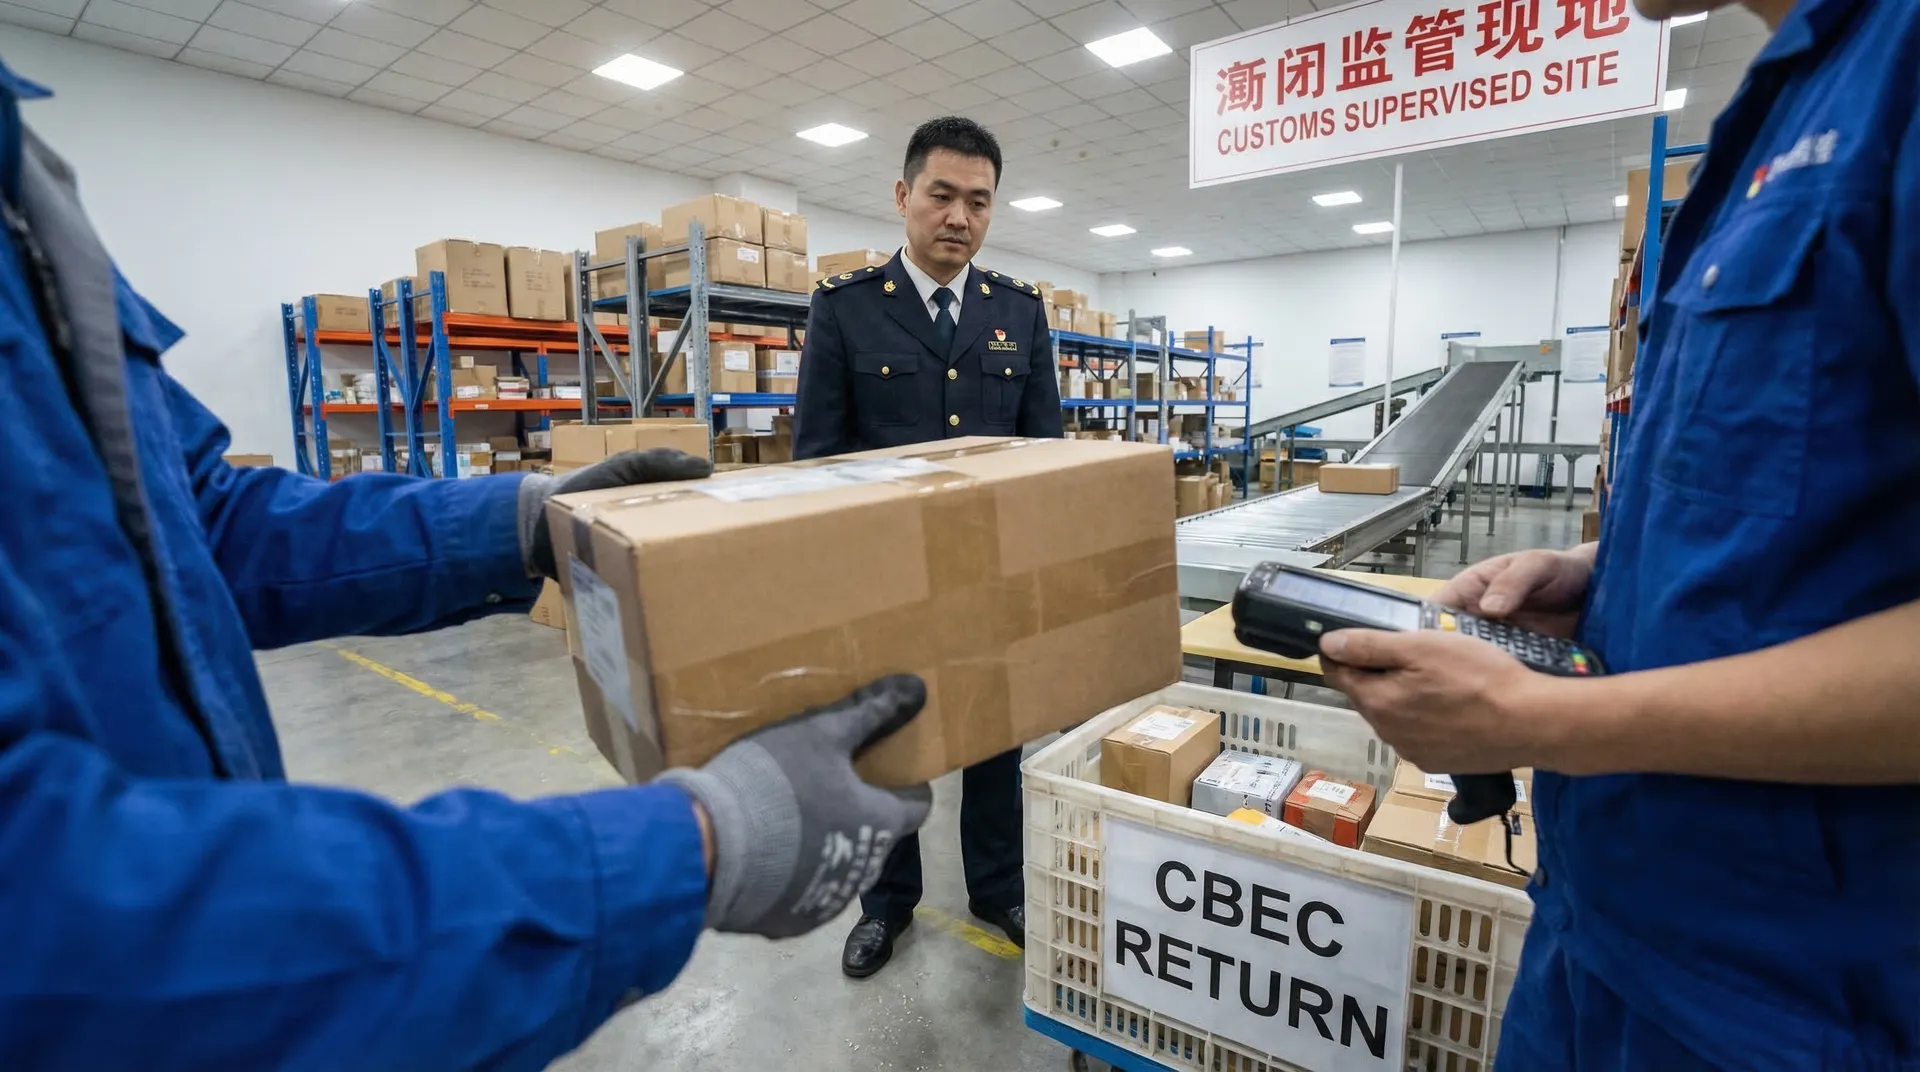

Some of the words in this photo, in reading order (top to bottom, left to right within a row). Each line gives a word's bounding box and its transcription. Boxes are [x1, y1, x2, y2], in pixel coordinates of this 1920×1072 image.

[1217, 108, 1336, 156] CUSTOMS
[1343, 69, 1533, 133] SUPERVISED
[1542, 49, 1619, 96] SITE
[1155, 860, 1345, 958] CBEC
[1115, 919, 1389, 1060] RETURN
